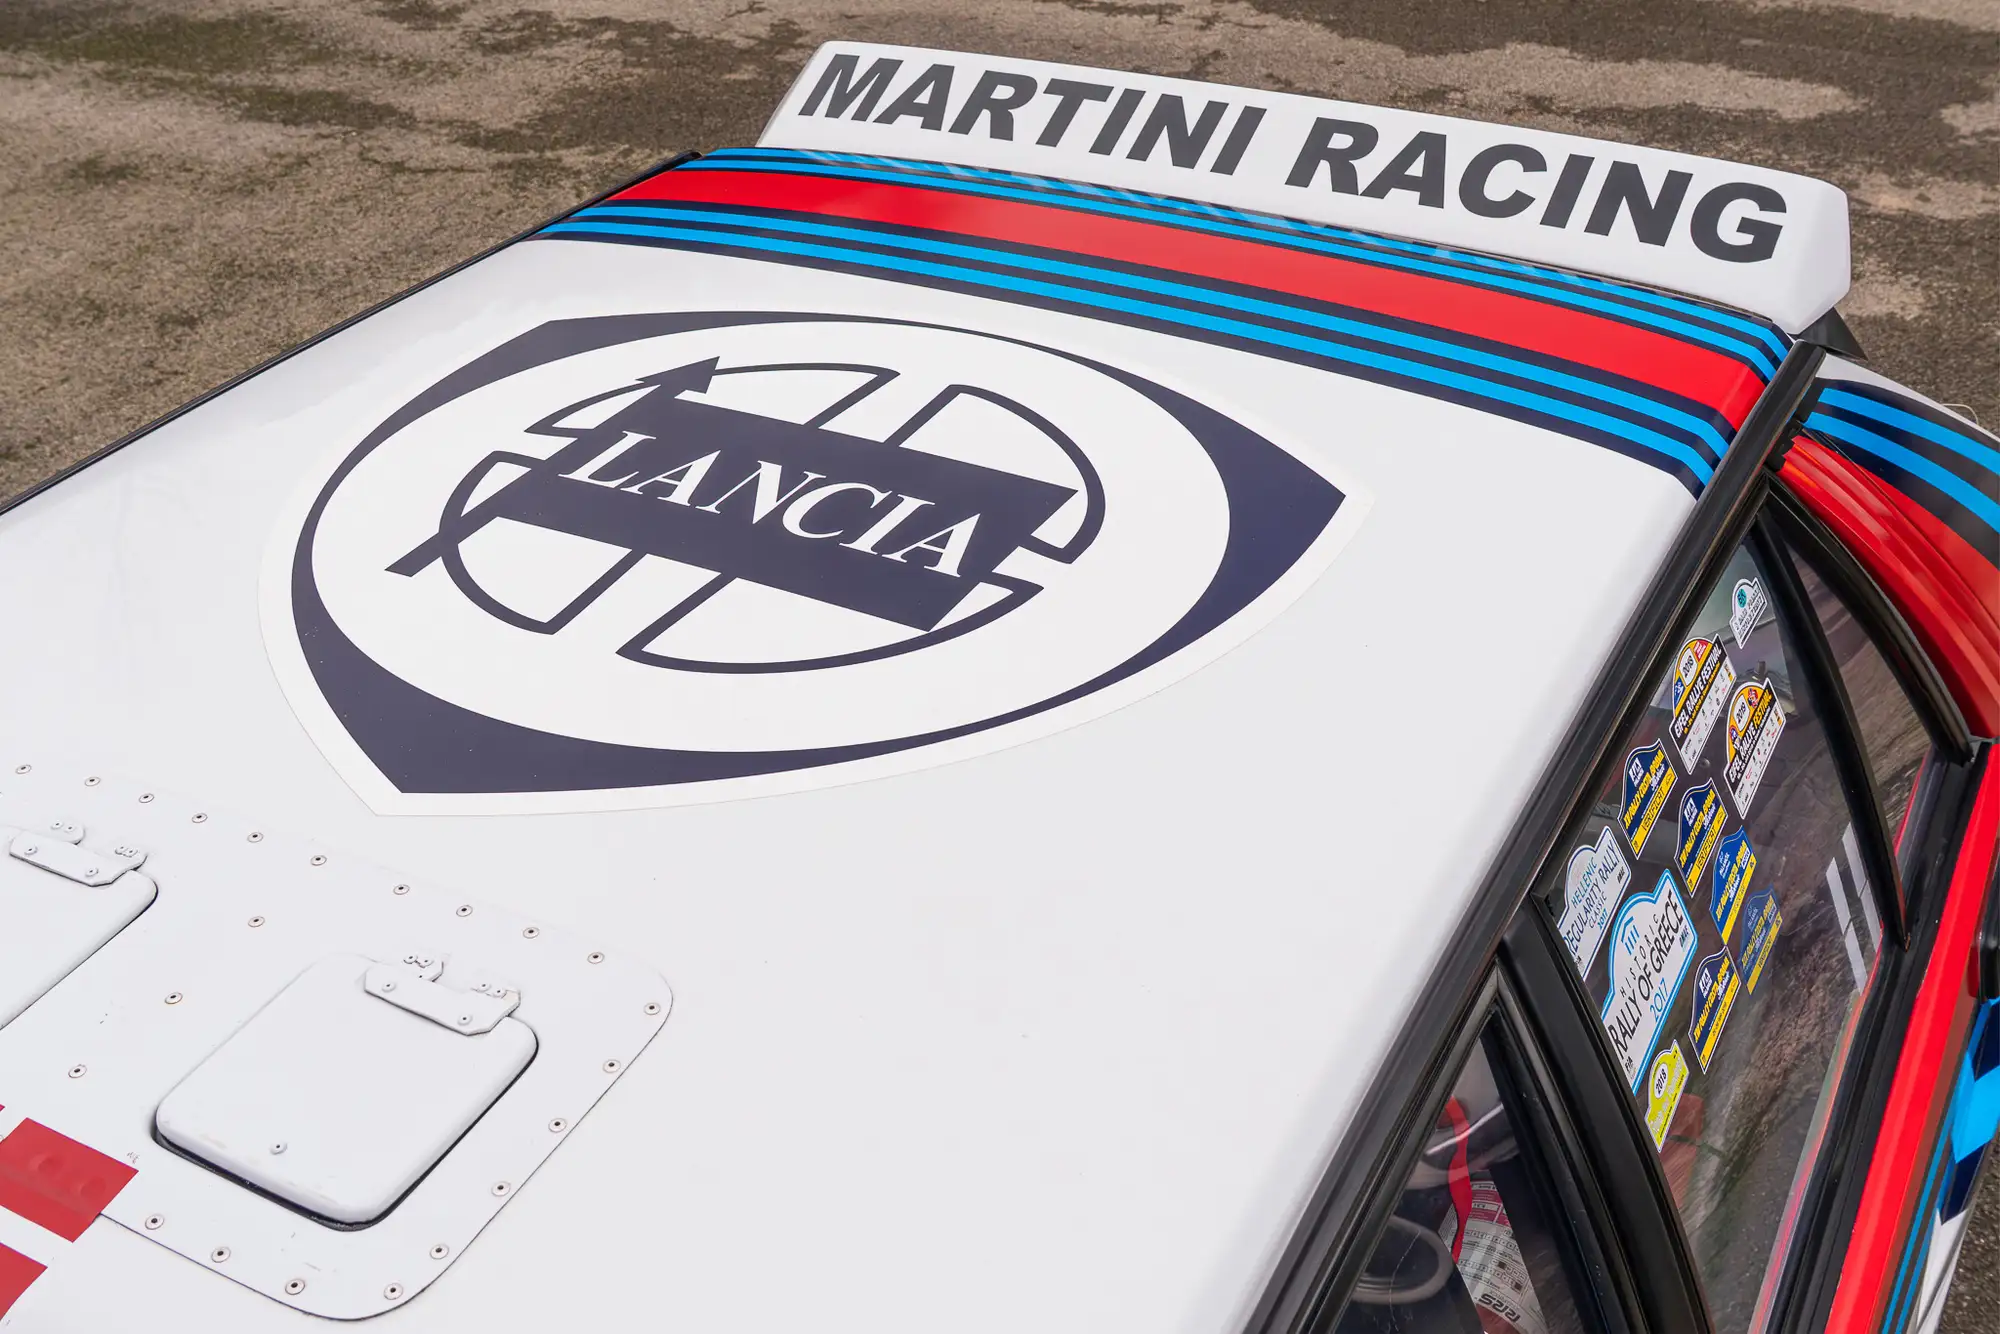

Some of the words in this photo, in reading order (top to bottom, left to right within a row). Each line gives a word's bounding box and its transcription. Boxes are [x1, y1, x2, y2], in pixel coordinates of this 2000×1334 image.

[798, 54, 1267, 176] MARTINI
[1284, 116, 1787, 263] RACING
[558, 431, 981, 577] LANCIA
[1682, 656, 1694, 677] 2018
[1674, 710, 1689, 737] EIFEL
[1685, 680, 1704, 712] RALLYE
[1700, 645, 1721, 682] FESTIVAL
[1735, 703, 1746, 723] 2019
[1728, 756, 1742, 781] EIFEL
[1738, 725, 1756, 758] RALLYE
[1752, 690, 1772, 727] FESTIVAL
[1641, 790, 1665, 829] VERIFICAT
[1695, 829, 1716, 868] VERIFICAT
[1563, 881, 1601, 955] REGULARITY
[1597, 844, 1620, 882] RALLY
[1570, 860, 1598, 907] HELLENIC
[1588, 894, 1607, 927] CLASSIC
[1597, 909, 1608, 930] 2017
[1608, 991, 1643, 1054] RALLY
[1636, 966, 1655, 1001] OF
[1648, 891, 1683, 968] GREECE
[1619, 916, 1658, 997] HISTORIC
[1649, 981, 1669, 1021] 2017
[1655, 1070, 1666, 1093] 2018
[1479, 1293, 1520, 1322] RRS
